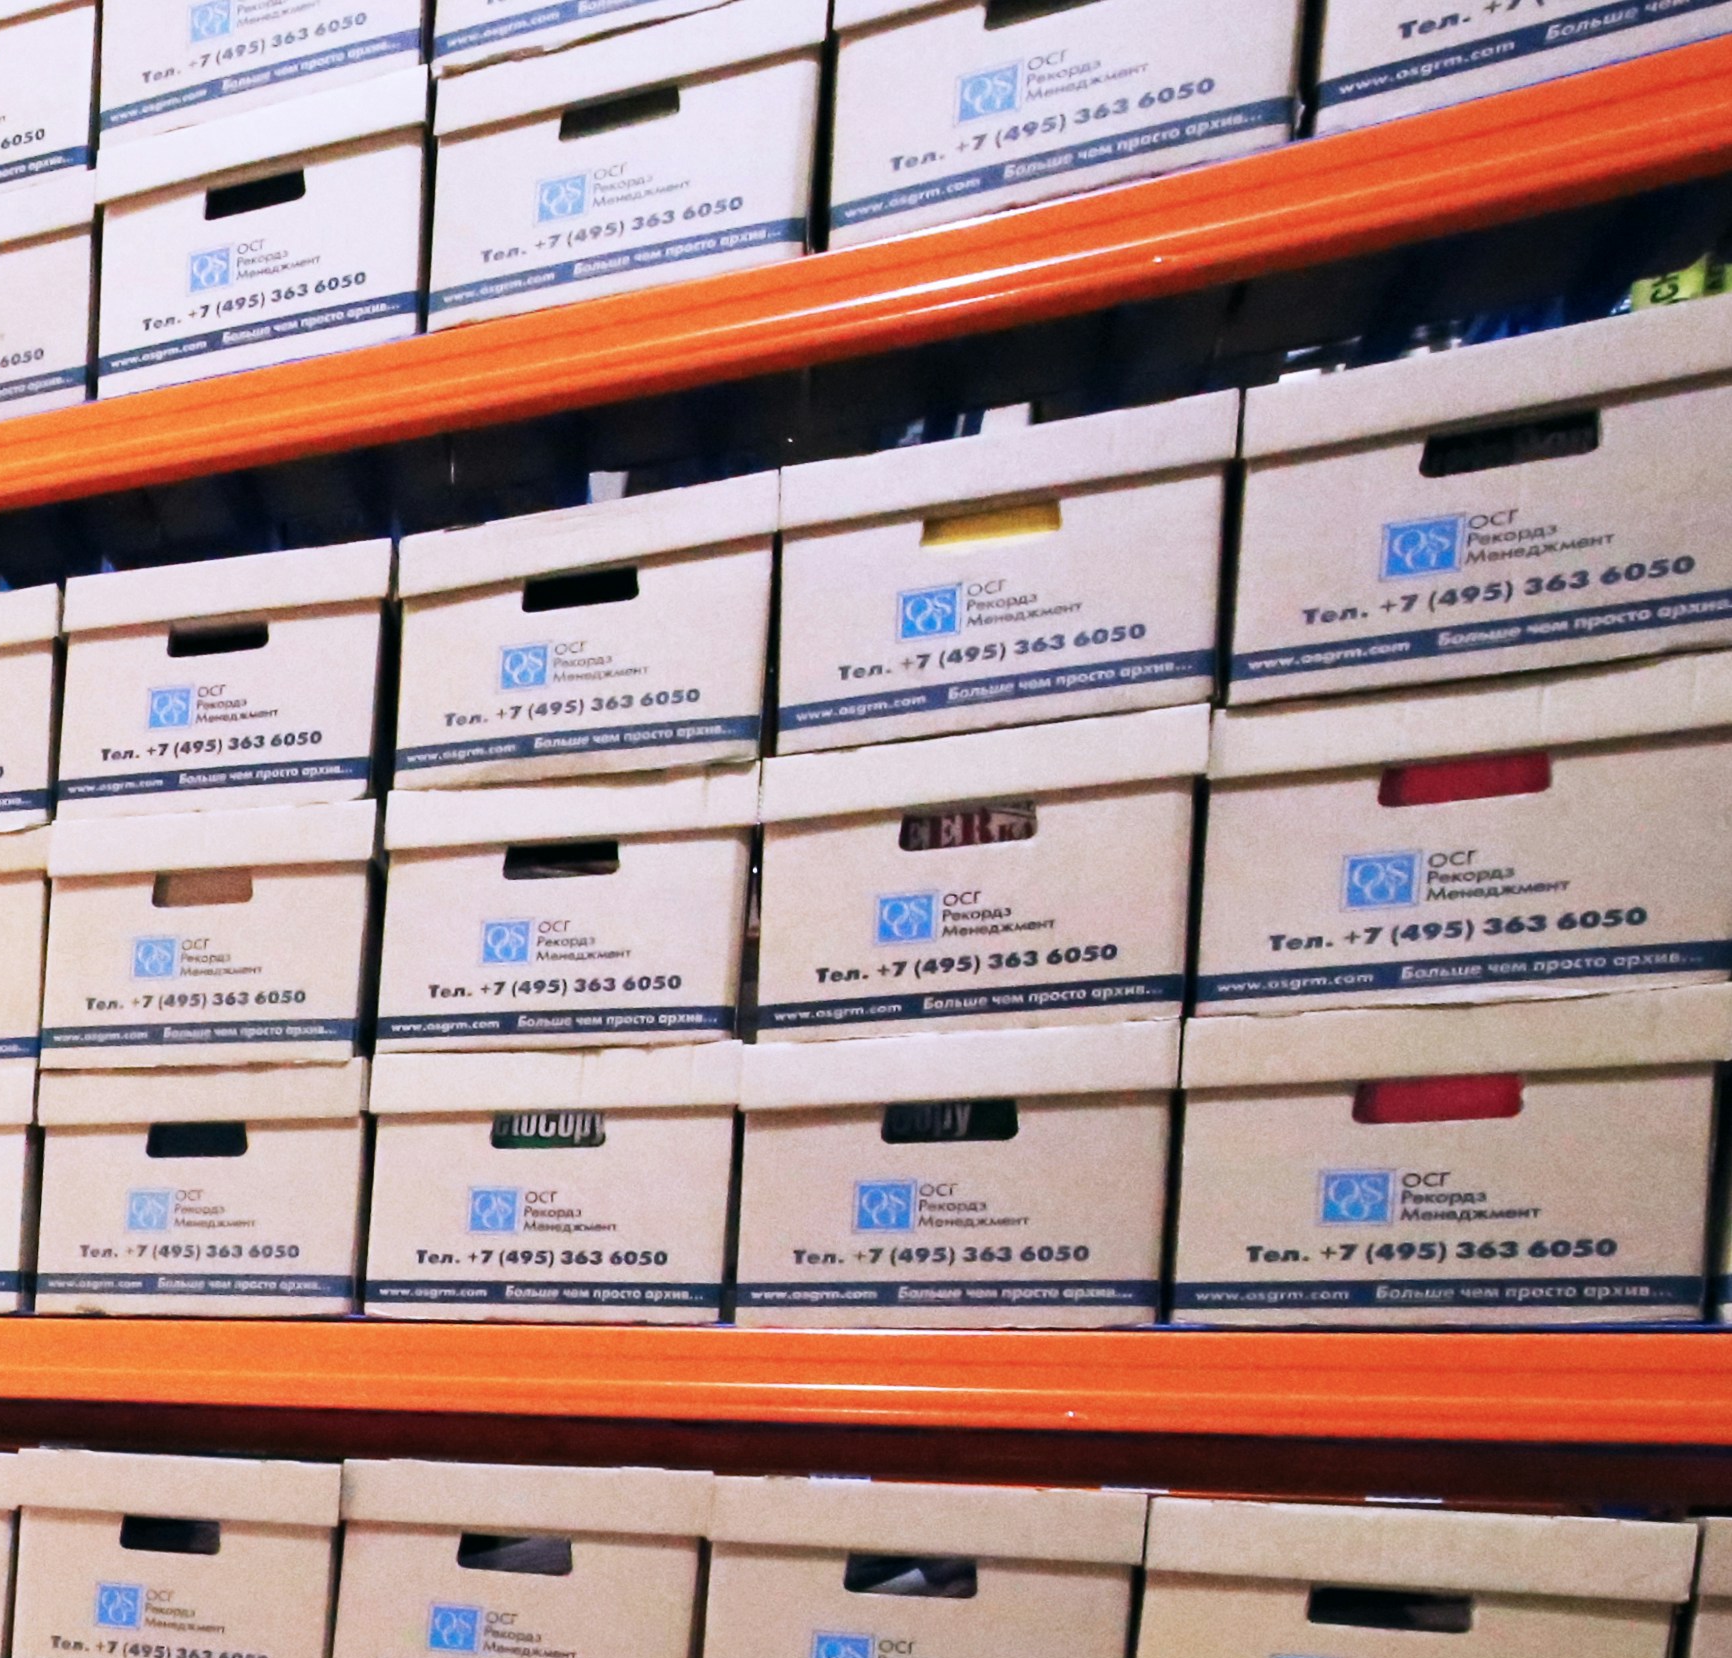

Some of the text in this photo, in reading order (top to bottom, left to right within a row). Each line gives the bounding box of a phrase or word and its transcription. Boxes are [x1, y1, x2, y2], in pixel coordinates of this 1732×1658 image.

[889, 73, 1215, 173] Тел. +7 (495) 363 6050
[142, 268, 366, 332] Тел. +7 (495) 363 6050
[1427, 848, 1478, 868] ОСГ
[1426, 862, 1514, 885] Рекордз
[942, 889, 982, 907] ОСГ
[1425, 877, 1570, 902] Менеджмент
[942, 902, 1011, 923] Рекордз
[941, 916, 1056, 938] Менеджмент
[1268, 905, 1648, 952] Тел. +7 (495) 363 6050
[815, 942, 1118, 984] Тел. +7 (495) 363 6050
[1487, 961, 1526, 974] чем
[1533, 955, 1606, 974] просто
[992, 993, 1023, 1005] чем
[1029, 988, 1086, 1004] просто
[1401, 1171, 1450, 1187] ОСГ
[1400, 1187, 1486, 1205] Рекордз
[1399, 1205, 1541, 1221] Менеджмент
[1245, 1237, 1617, 1265] Тел. +7 (495) 363 6050
[1460, 1287, 1499, 1298] чем
[1505, 1286, 1577, 1300] просто
